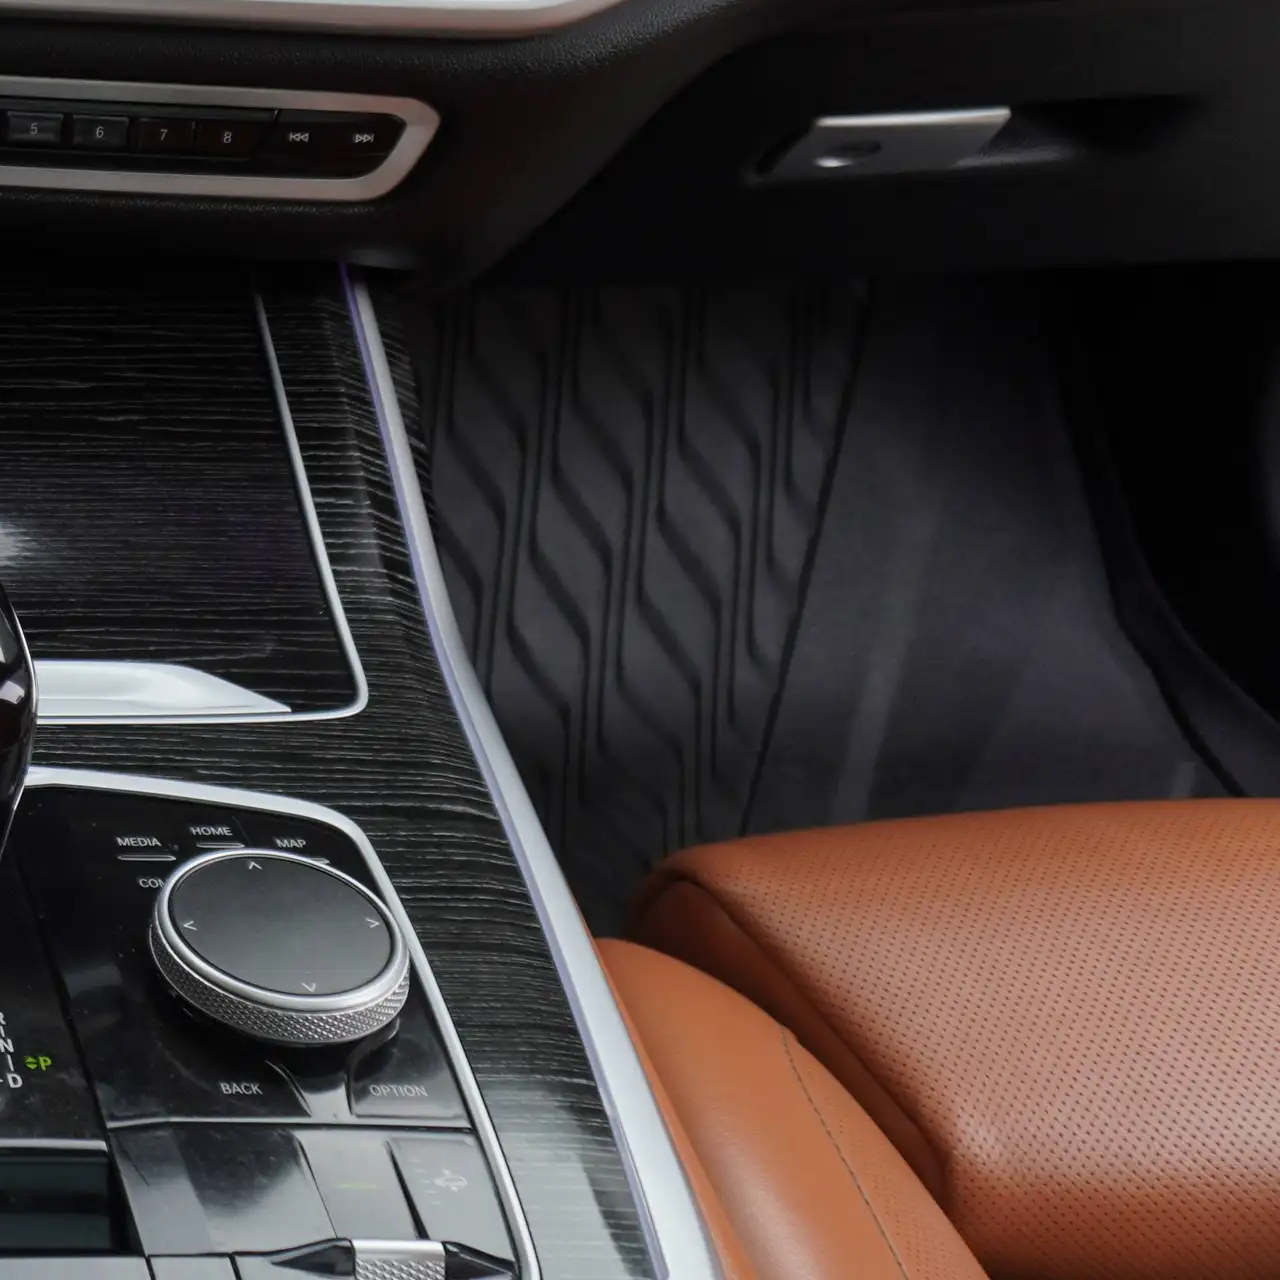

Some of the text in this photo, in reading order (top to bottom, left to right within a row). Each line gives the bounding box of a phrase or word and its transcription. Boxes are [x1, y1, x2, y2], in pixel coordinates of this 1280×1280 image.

[30, 123, 39, 135] 5
[95, 126, 105, 139] 6
[159, 129, 168, 141] 7
[223, 131, 232, 143] 8
[190, 826, 234, 836] HOME
[117, 837, 162, 847] MEDIA
[275, 838, 307, 848] MAP
[39, 1056, 52, 1071] P
[6, 1073, 23, 1088] D
[221, 1083, 263, 1096] BACK
[370, 1084, 428, 1098] OPTION
